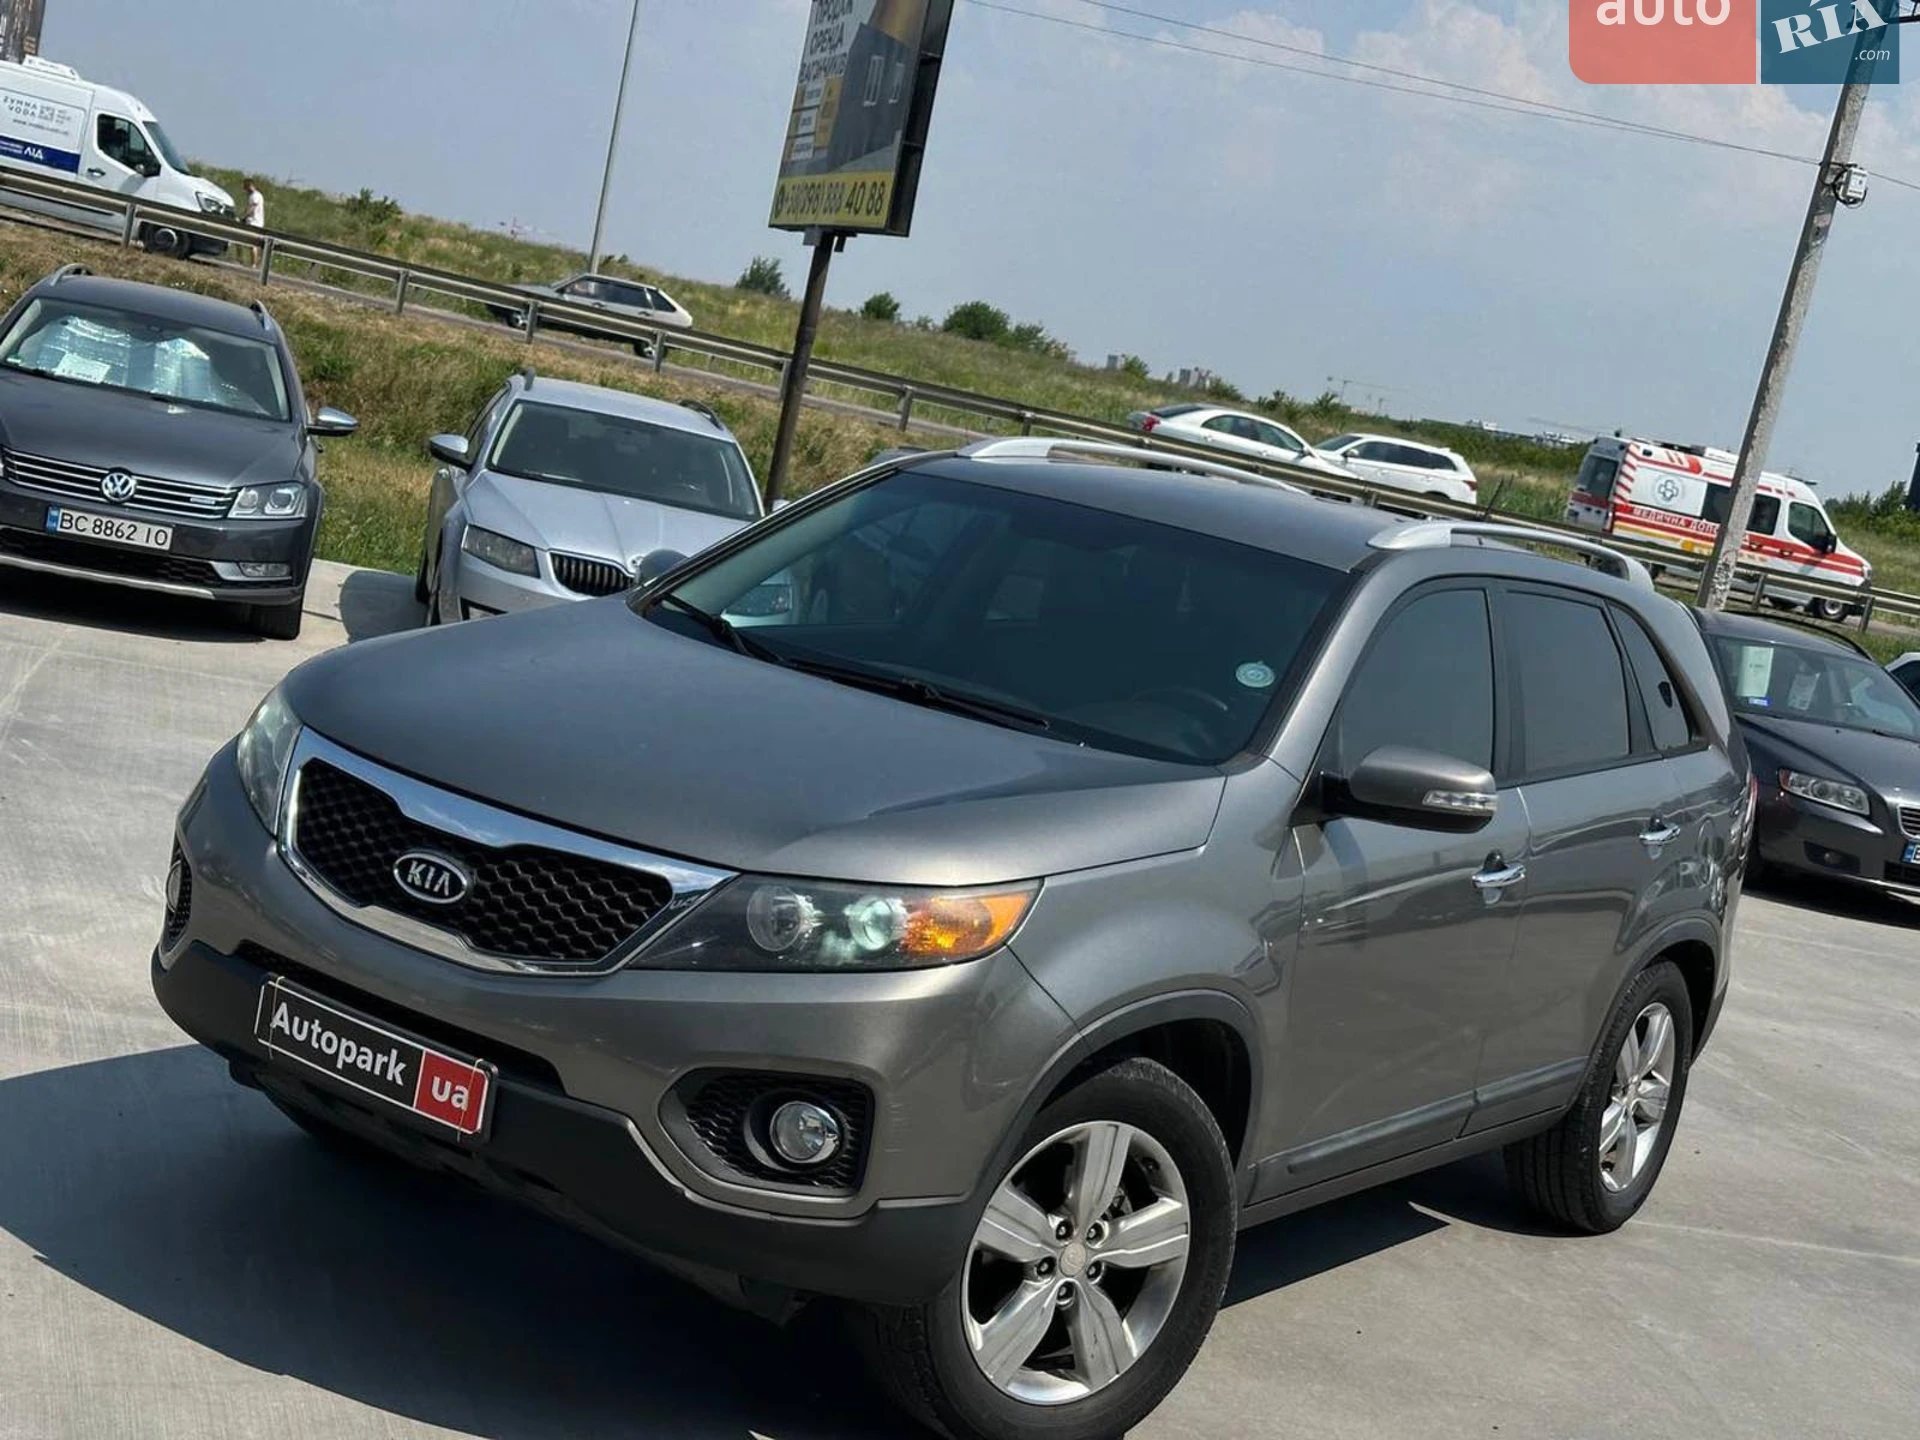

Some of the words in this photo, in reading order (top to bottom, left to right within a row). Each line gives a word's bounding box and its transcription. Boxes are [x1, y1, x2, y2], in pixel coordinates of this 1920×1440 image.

[845, 181, 866, 215] 40
[866, 181, 886, 216] 88
[60, 511, 89, 533] BC
[92, 518, 138, 541] 8862
[406, 860, 451, 898] KIA
[270, 1002, 408, 1086] Autopark
[431, 1074, 470, 1112] ua
